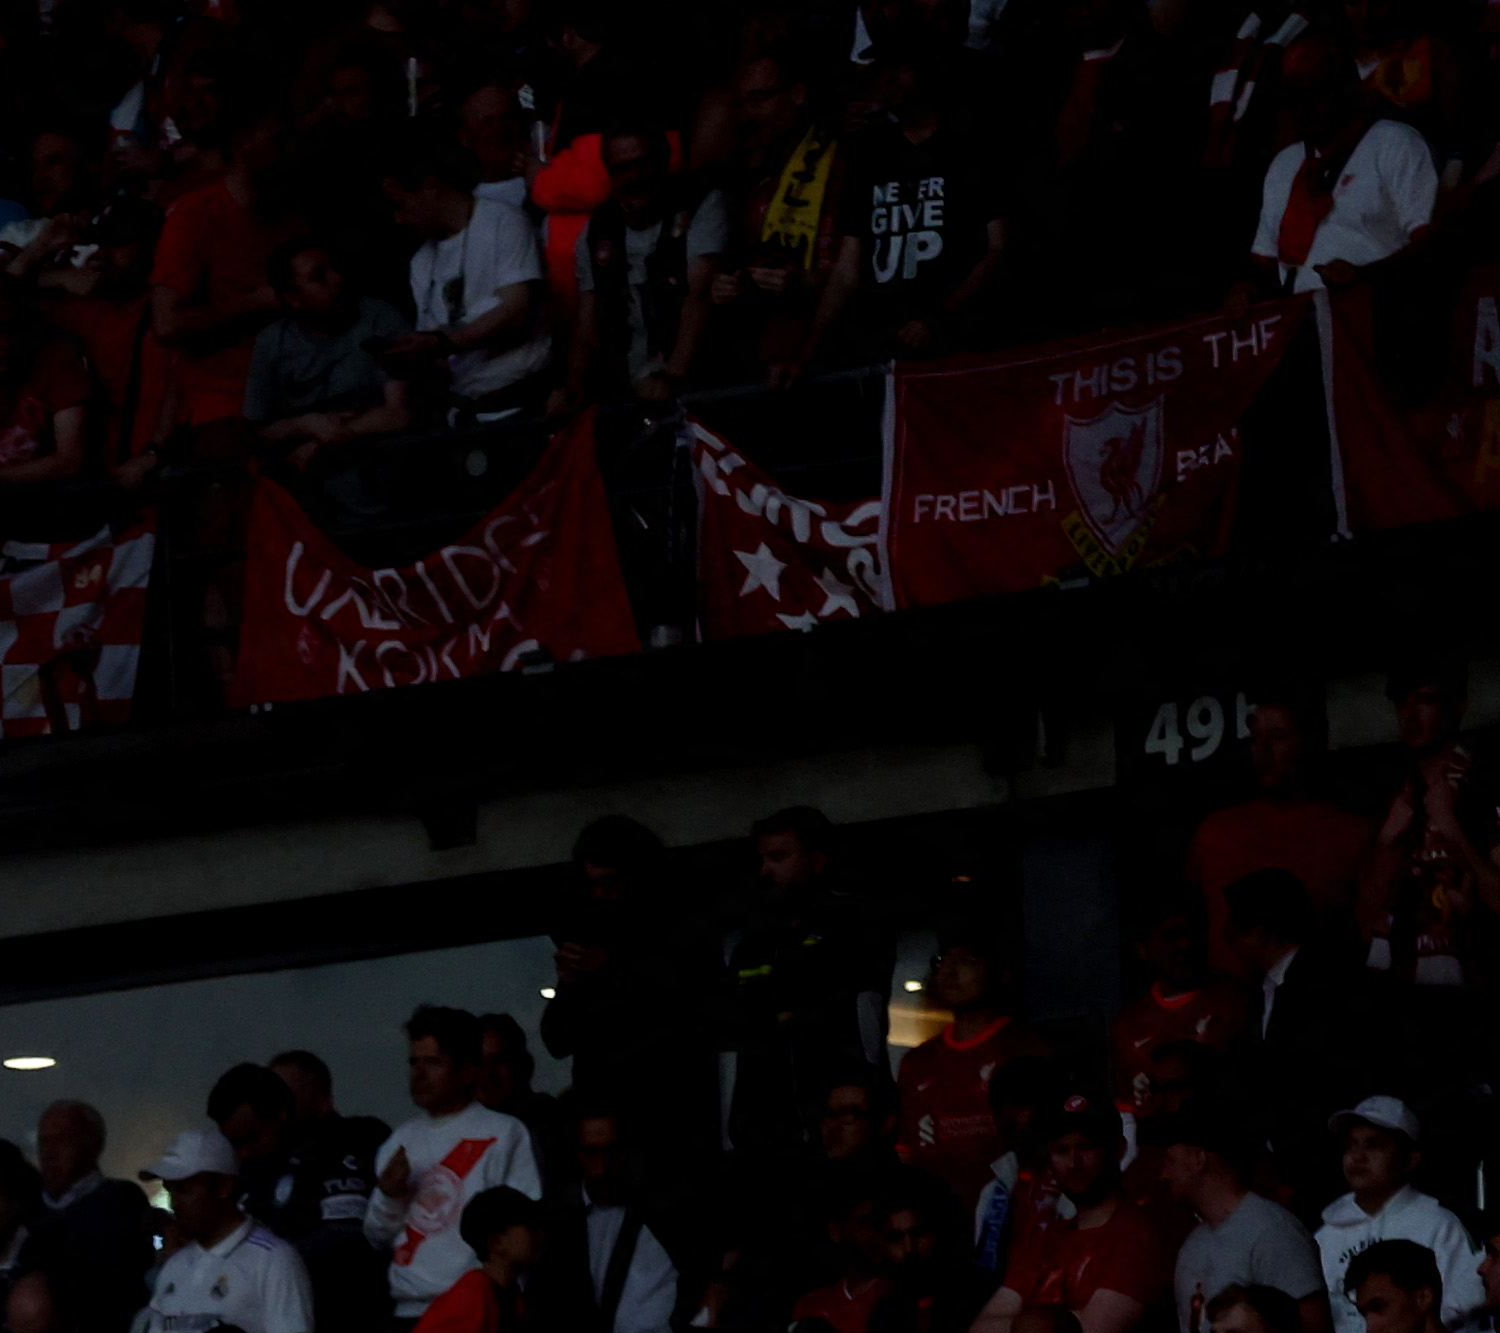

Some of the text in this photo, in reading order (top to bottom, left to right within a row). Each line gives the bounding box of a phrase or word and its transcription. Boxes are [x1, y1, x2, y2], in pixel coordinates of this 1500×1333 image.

[872, 176, 945, 207] NEER
[870, 200, 945, 235] GIVE
[871, 230, 944, 284] UP
[1048, 357, 1138, 406] THIS
[1146, 345, 1184, 385] IS
[913, 479, 1057, 514] FRENCH
[1144, 695, 1226, 766] 49
